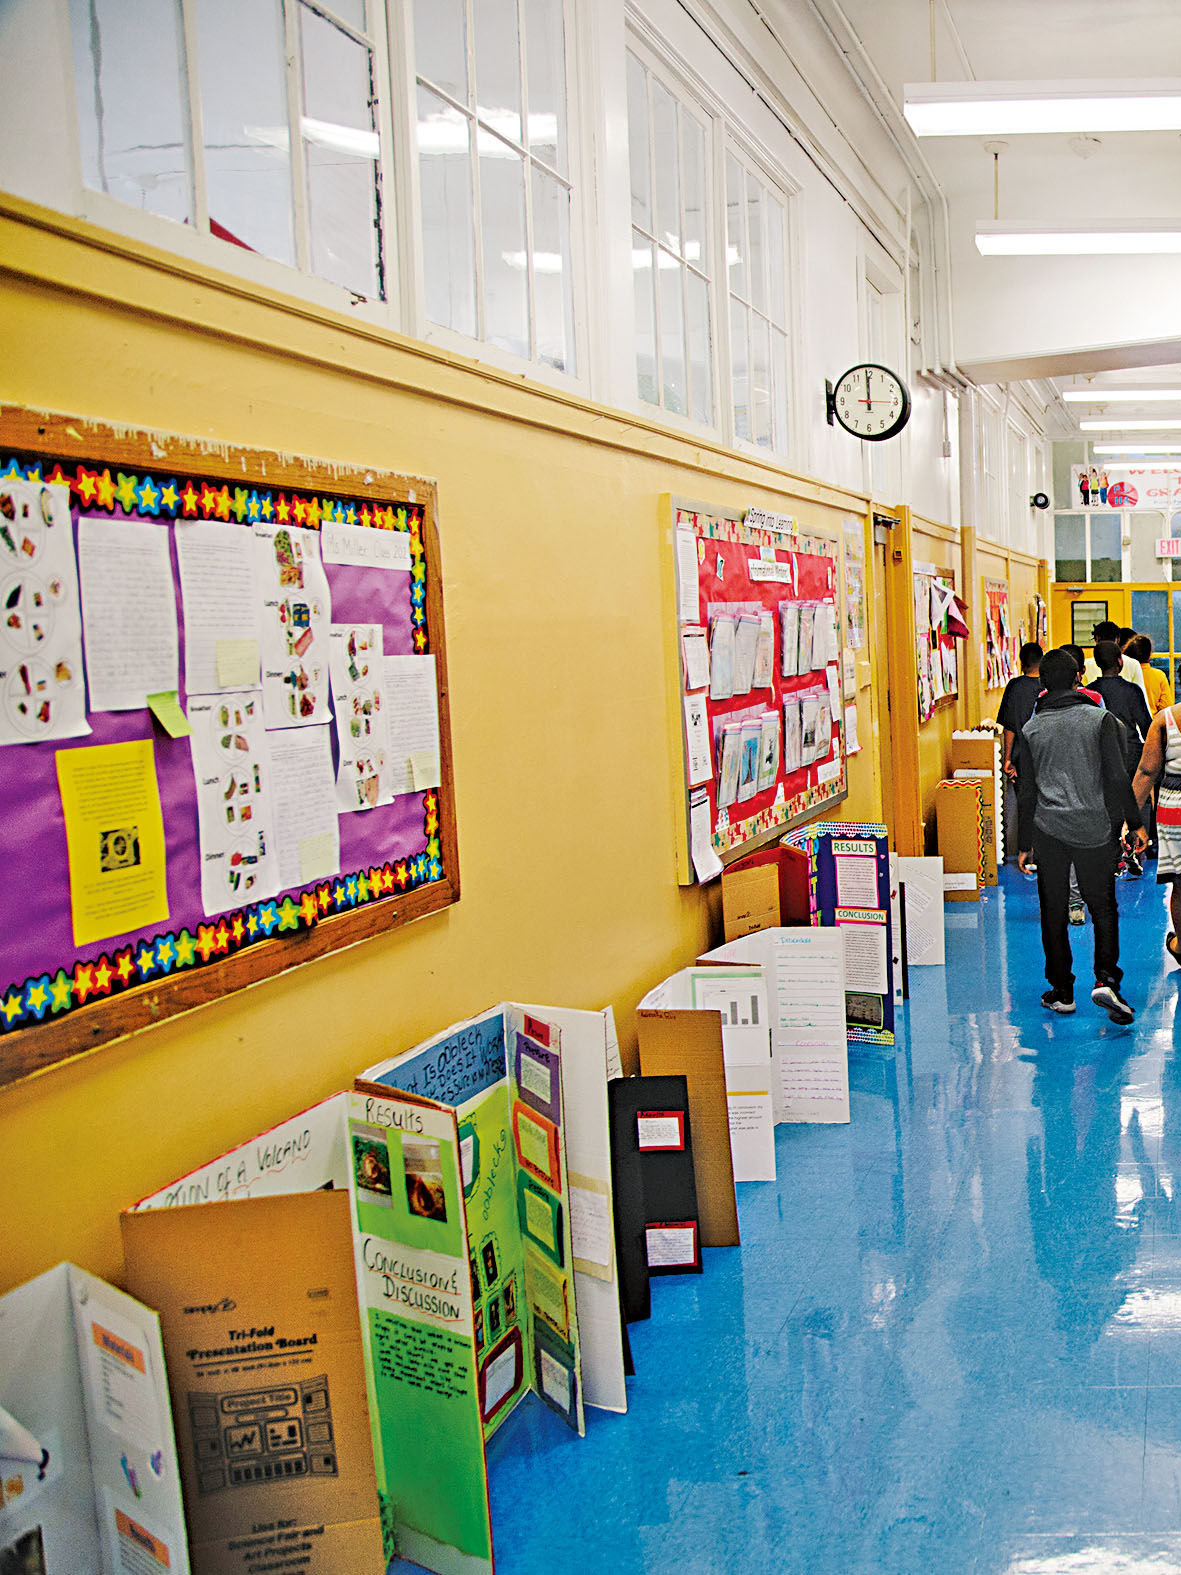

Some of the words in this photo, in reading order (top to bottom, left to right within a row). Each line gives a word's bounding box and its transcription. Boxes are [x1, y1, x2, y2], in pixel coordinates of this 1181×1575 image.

[853, 374, 860, 383] 11
[843, 384, 851, 392] 10
[840, 397, 845, 406] 9
[844, 410, 850, 419] 8
[889, 410, 894, 419] 4
[854, 420, 859, 428] 7
[866, 424, 872, 433] 6
[880, 420, 885, 429] 5
[1160, 539, 1180, 555] EXIT
[203, 777, 219, 785] Lunch
[834, 842, 874, 853] RESULTS
[205, 852, 225, 861] Dinner
[838, 910, 884, 920] CONCLUSION
[363, 1238, 448, 1290] CONCLUSION
[228, 1326, 274, 1341] Tri-Fold
[186, 1341, 273, 1360] Presentation
[275, 1333, 318, 1349] Board
[227, 1394, 266, 1408] Project
[269, 1390, 291, 1404] Title
[228, 1535, 275, 1550] Science
[277, 1530, 299, 1542] Fair
[302, 1525, 325, 1538] and
